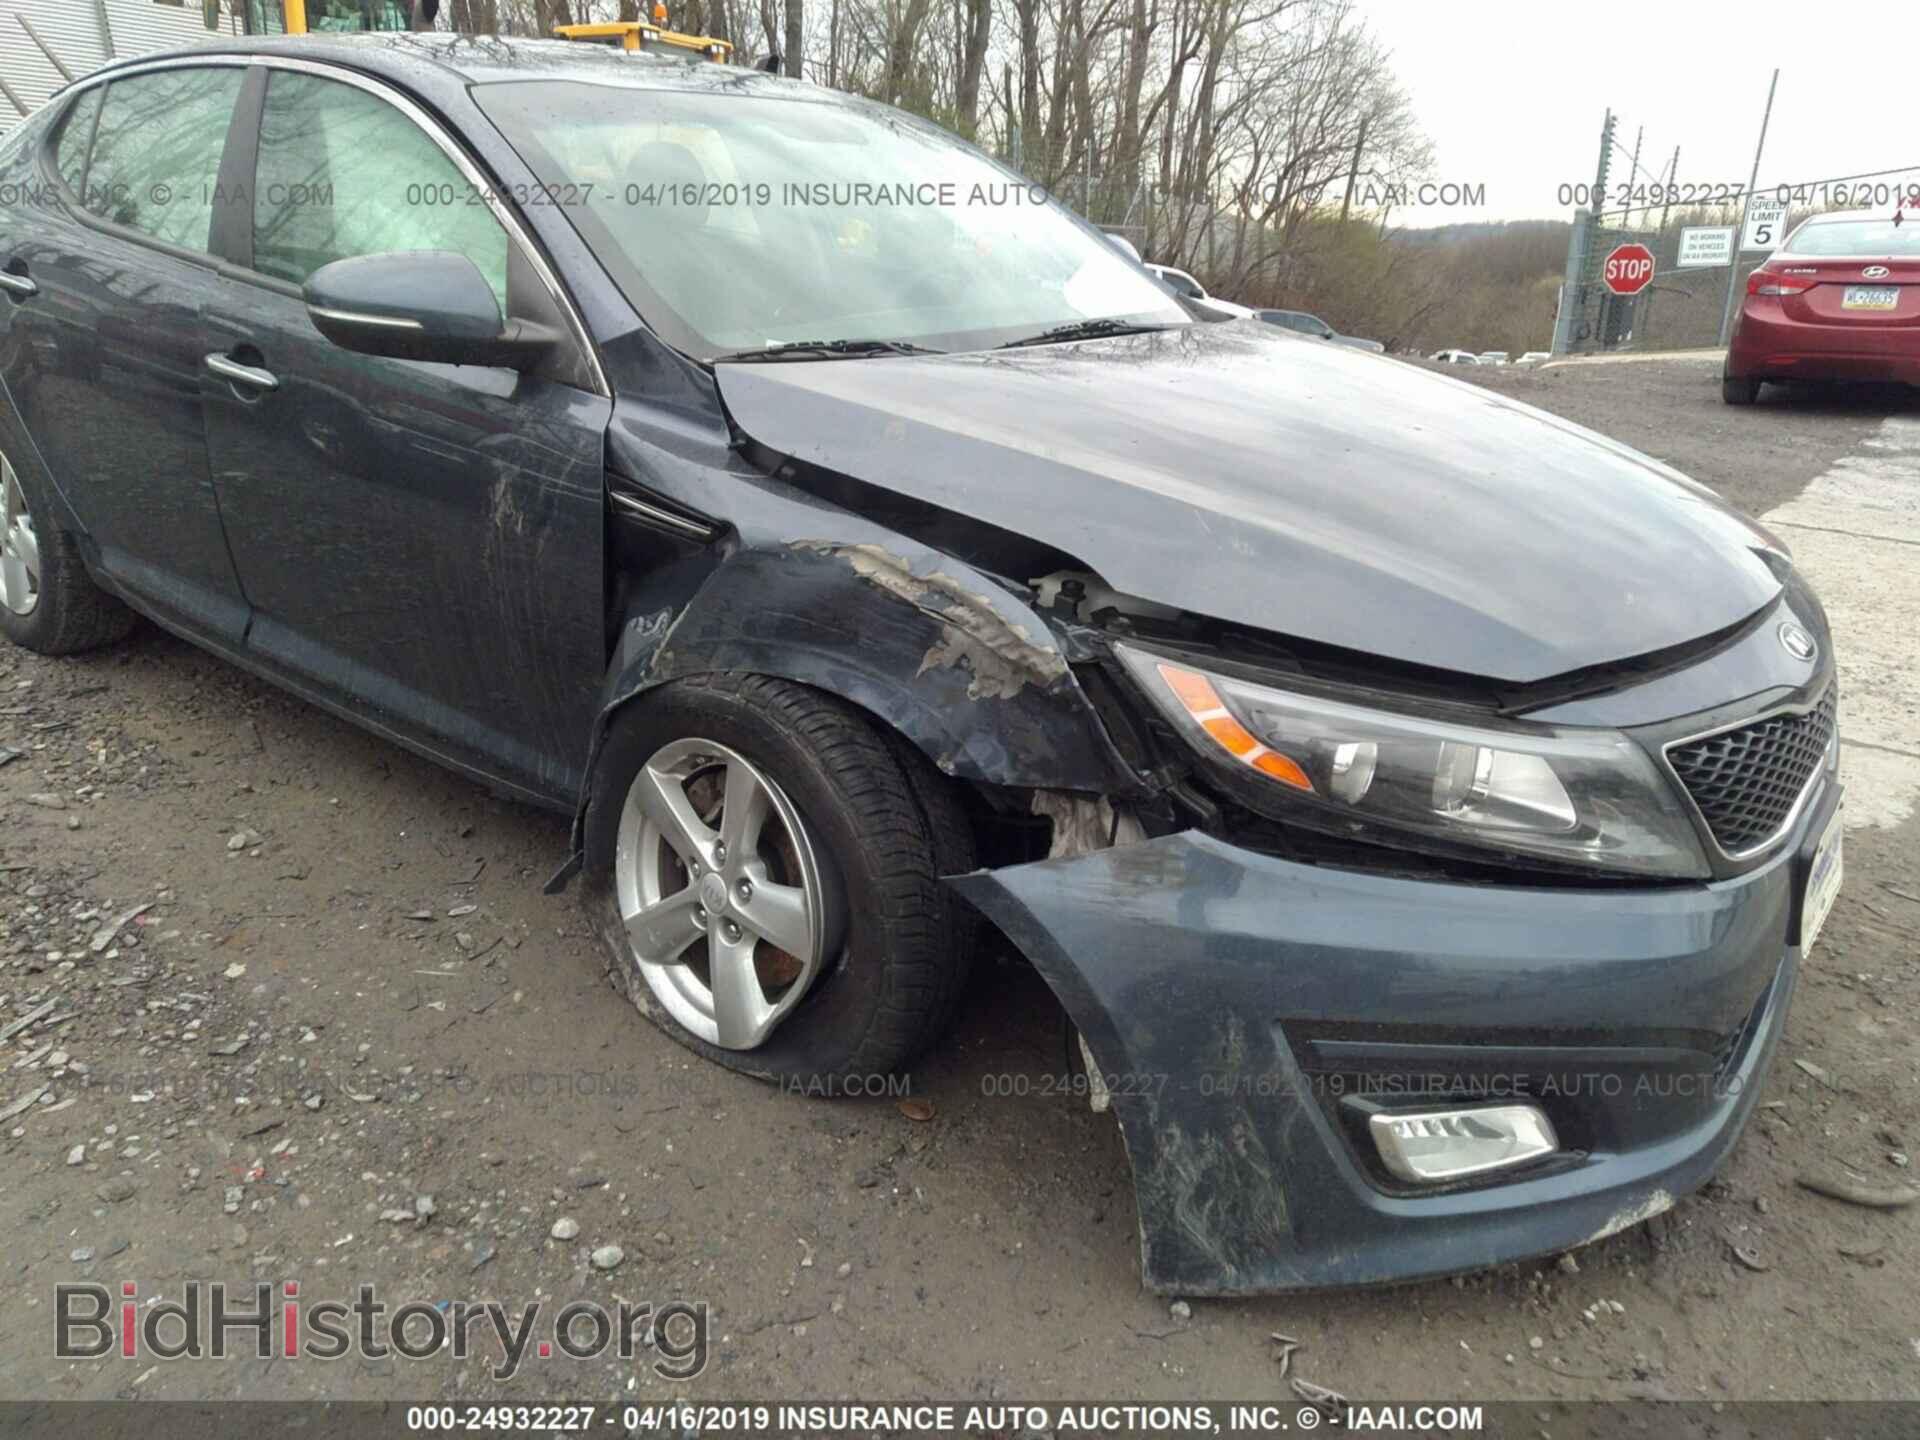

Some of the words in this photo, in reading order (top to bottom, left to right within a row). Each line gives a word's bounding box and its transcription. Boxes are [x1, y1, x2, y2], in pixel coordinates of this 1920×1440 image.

[1751, 200, 1785, 211] SPEED
[1751, 211, 1782, 221] LIMIT
[1754, 224, 1773, 244] 5
[1606, 257, 1652, 281] STOP
